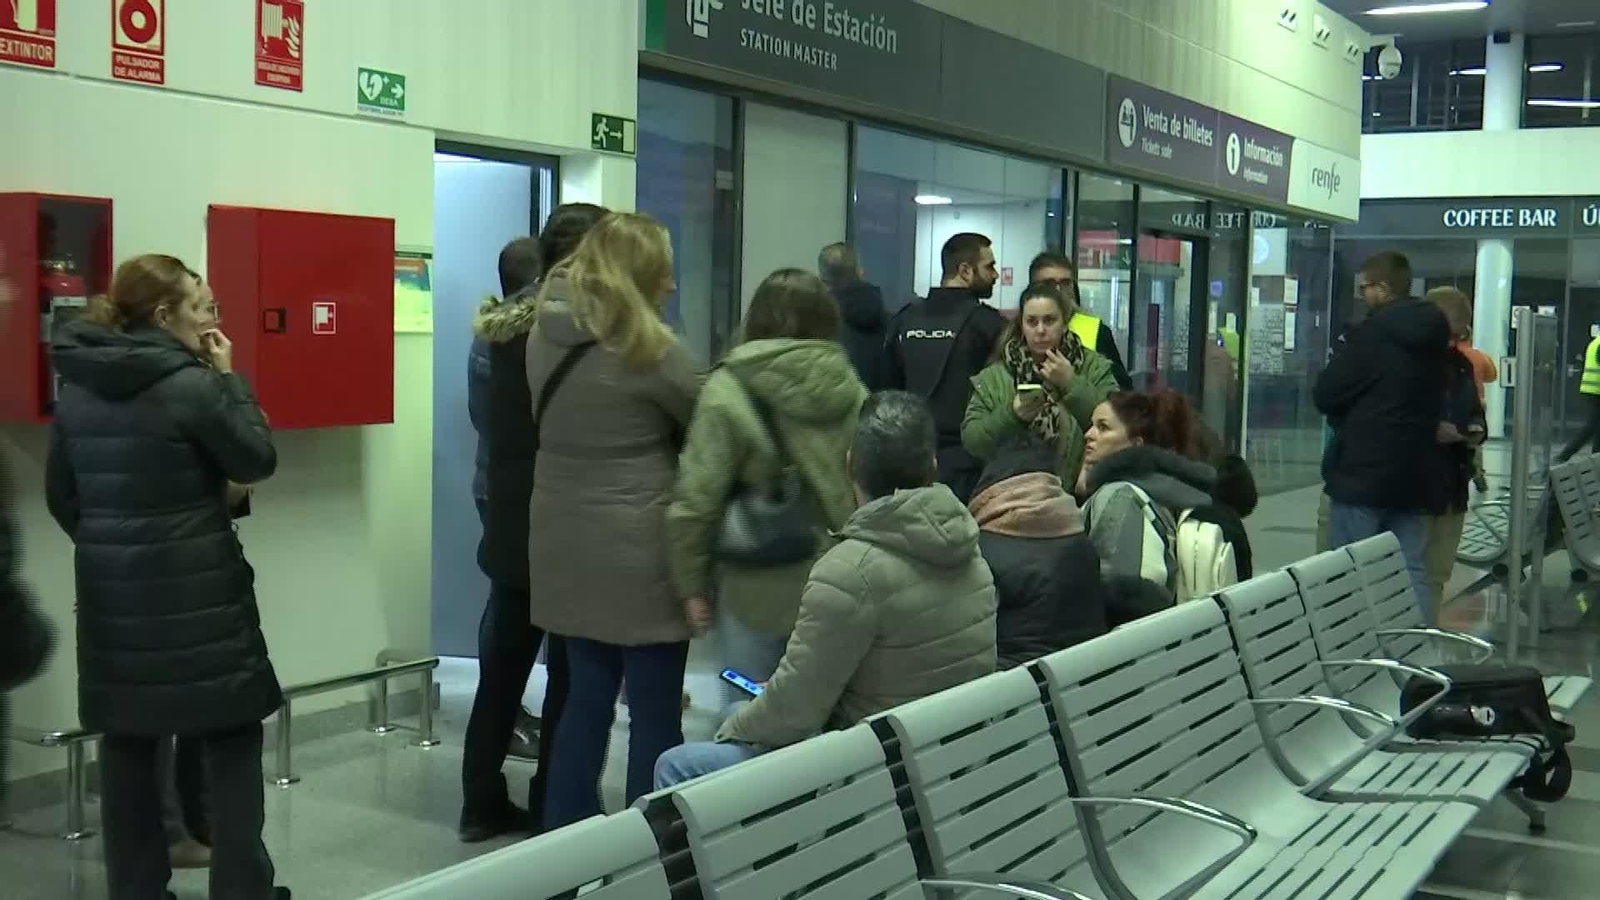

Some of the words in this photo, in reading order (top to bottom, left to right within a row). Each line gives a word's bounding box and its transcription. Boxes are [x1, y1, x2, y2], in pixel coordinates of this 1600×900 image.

[791, 0, 817, 30] de
[823, 1, 897, 54] Estación
[0, 38, 54, 62] EXTINTOR
[740, 28, 790, 58] STATION
[793, 43, 838, 71] MASTER
[116, 54, 160, 69] PULSADOR
[115, 66, 126, 77] DE
[128, 68, 161, 81] ALARMA
[1142, 104, 1168, 134] Venta
[1170, 113, 1181, 138] de
[1183, 115, 1213, 147] billetes
[1141, 137, 1160, 156] Tickets
[1243, 138, 1284, 168] Información
[1311, 161, 1341, 200] renfe
[1443, 208, 1514, 227] COFFEE
[1518, 208, 1556, 227] BAR
[1582, 203, 1600, 226] Ú
[906, 329, 954, 339] POLICIA
